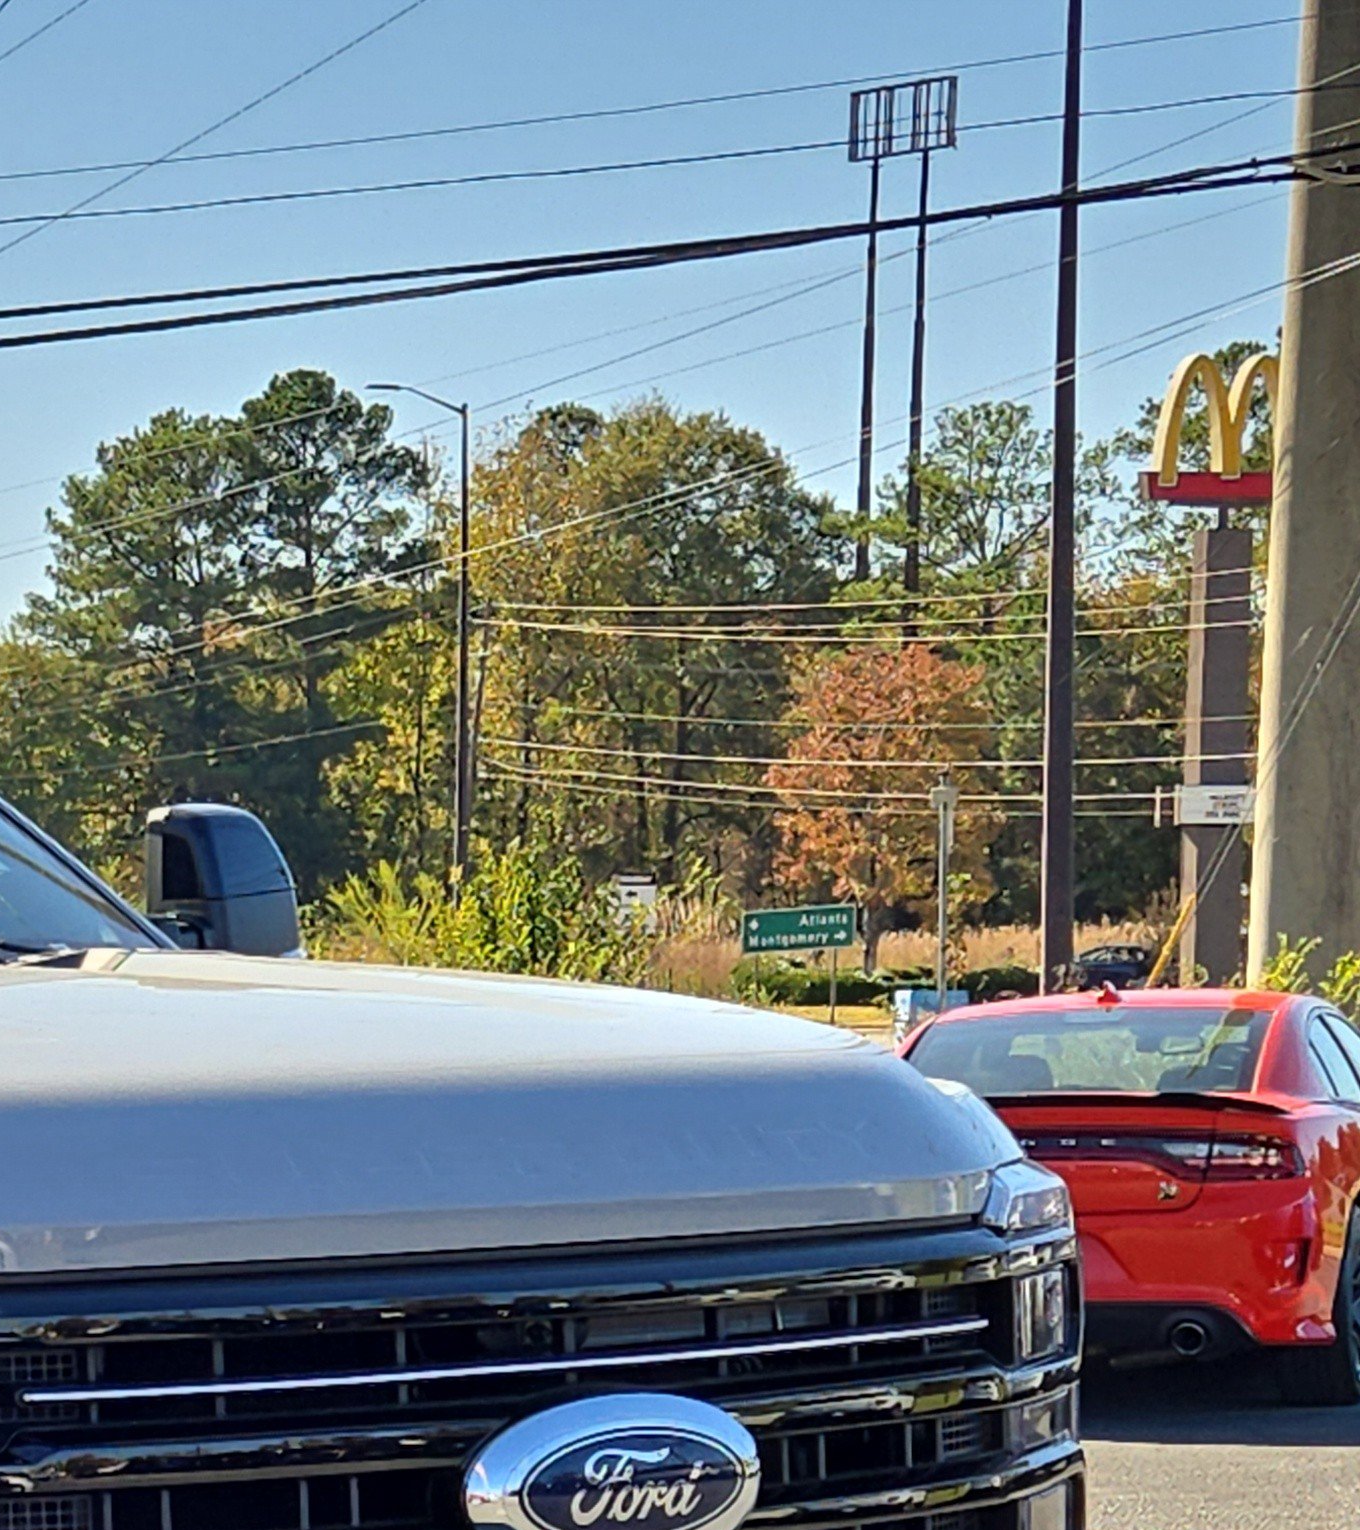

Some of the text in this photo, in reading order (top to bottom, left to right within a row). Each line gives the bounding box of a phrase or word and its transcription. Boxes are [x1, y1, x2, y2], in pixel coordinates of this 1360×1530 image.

[799, 913, 848, 926] Atlanta
[749, 932, 829, 948] Montgomery
[570, 1446, 702, 1527] Ford
